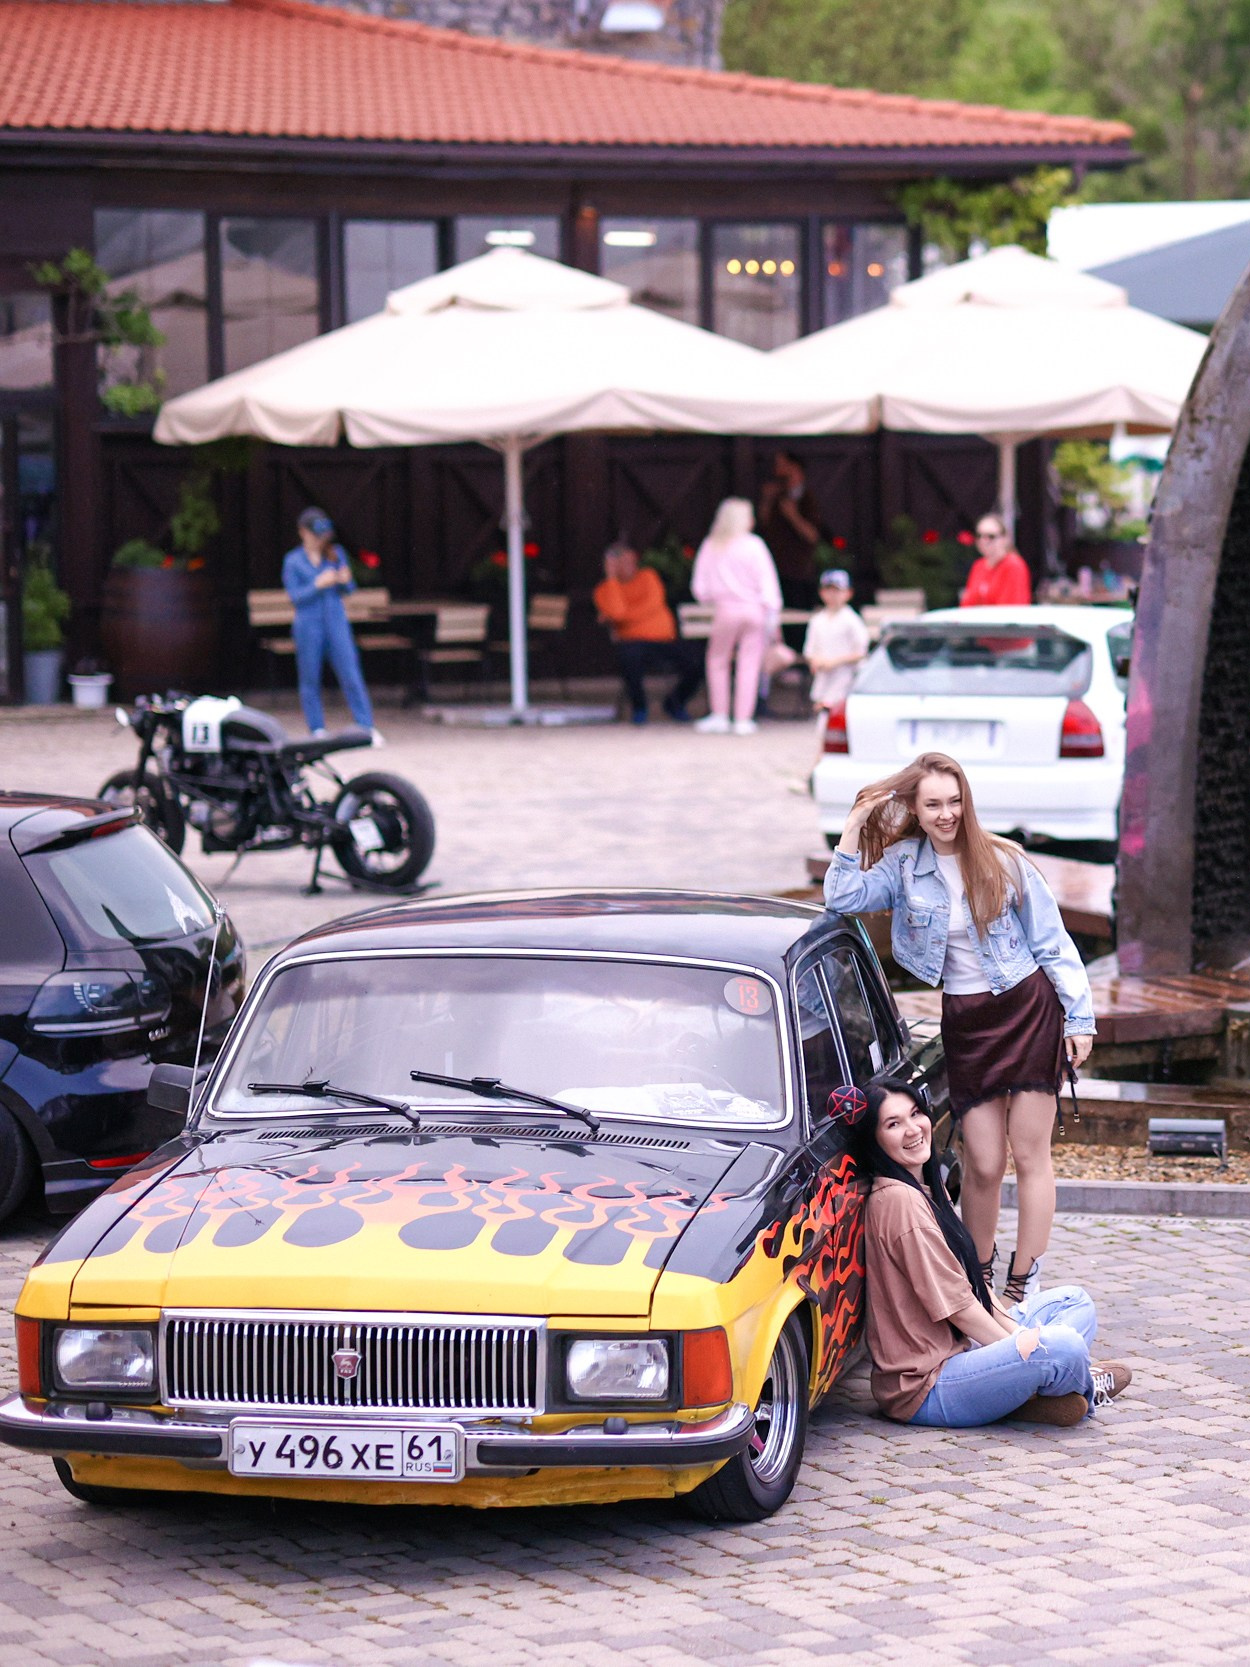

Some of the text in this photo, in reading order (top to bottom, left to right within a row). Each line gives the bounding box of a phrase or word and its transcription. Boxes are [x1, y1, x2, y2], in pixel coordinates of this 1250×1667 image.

[739, 984, 759, 1009] 13
[407, 1434, 442, 1461] 61
[405, 1461, 432, 1473] RUS
